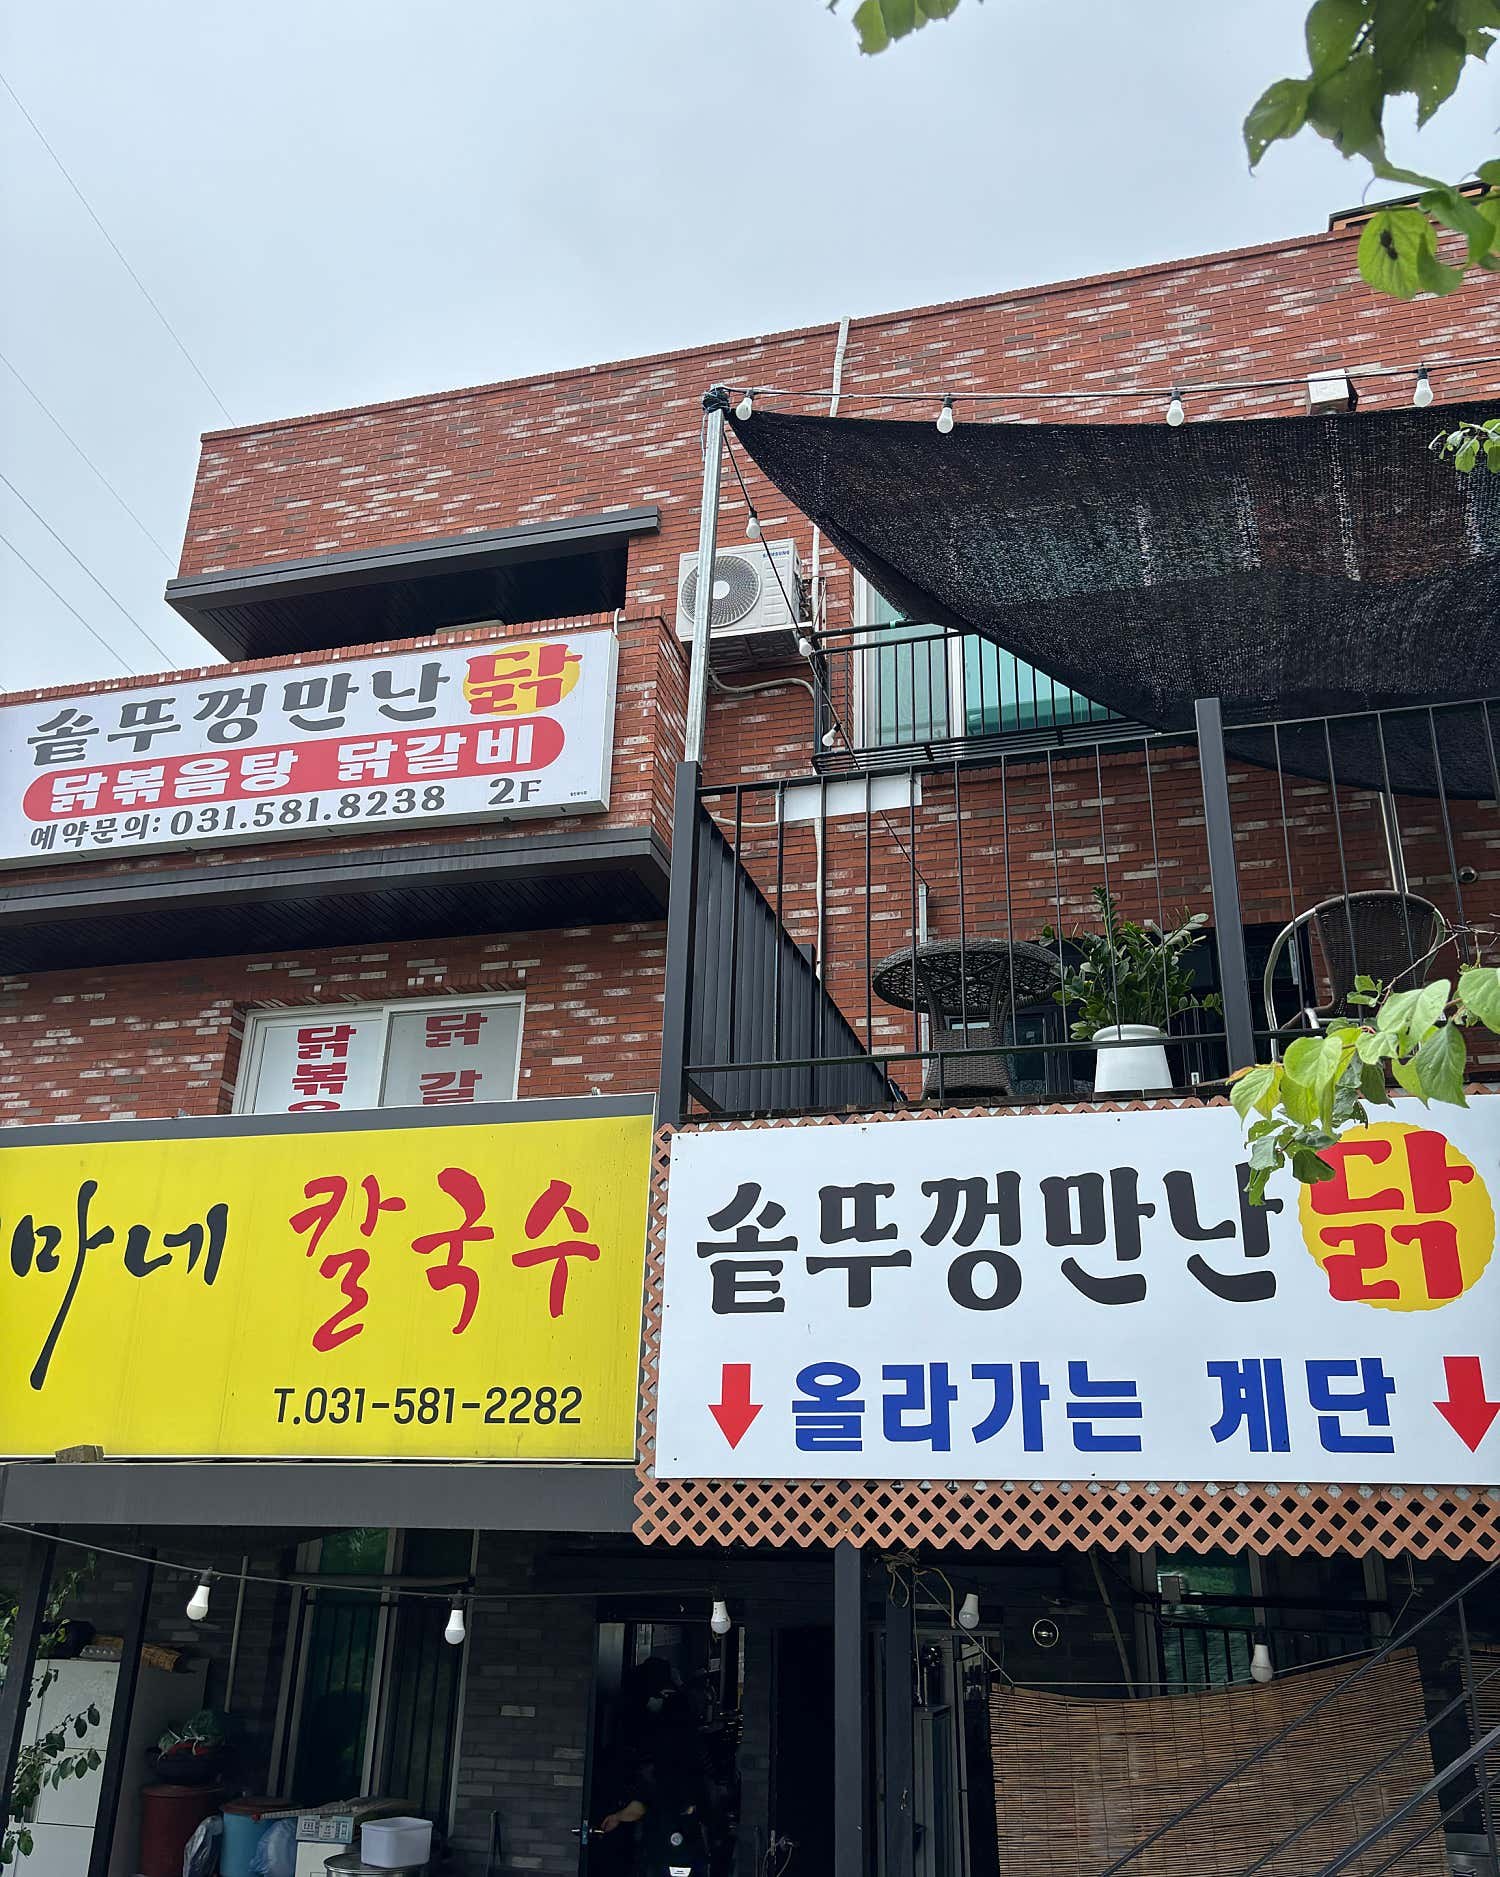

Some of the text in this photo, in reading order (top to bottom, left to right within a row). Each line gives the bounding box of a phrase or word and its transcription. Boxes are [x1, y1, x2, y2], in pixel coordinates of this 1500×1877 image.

[51, 724, 534, 812] 닭볶음탕 닭갈비
[171, 785, 446, 836] 031.581.8238
[488, 777, 542, 805] 2F
[0, 1167, 601, 1391] 마네 칼국수
[274, 1386, 583, 1424] T.031-581-2282
[791, 1357, 1397, 1454] 올라가는 계단
